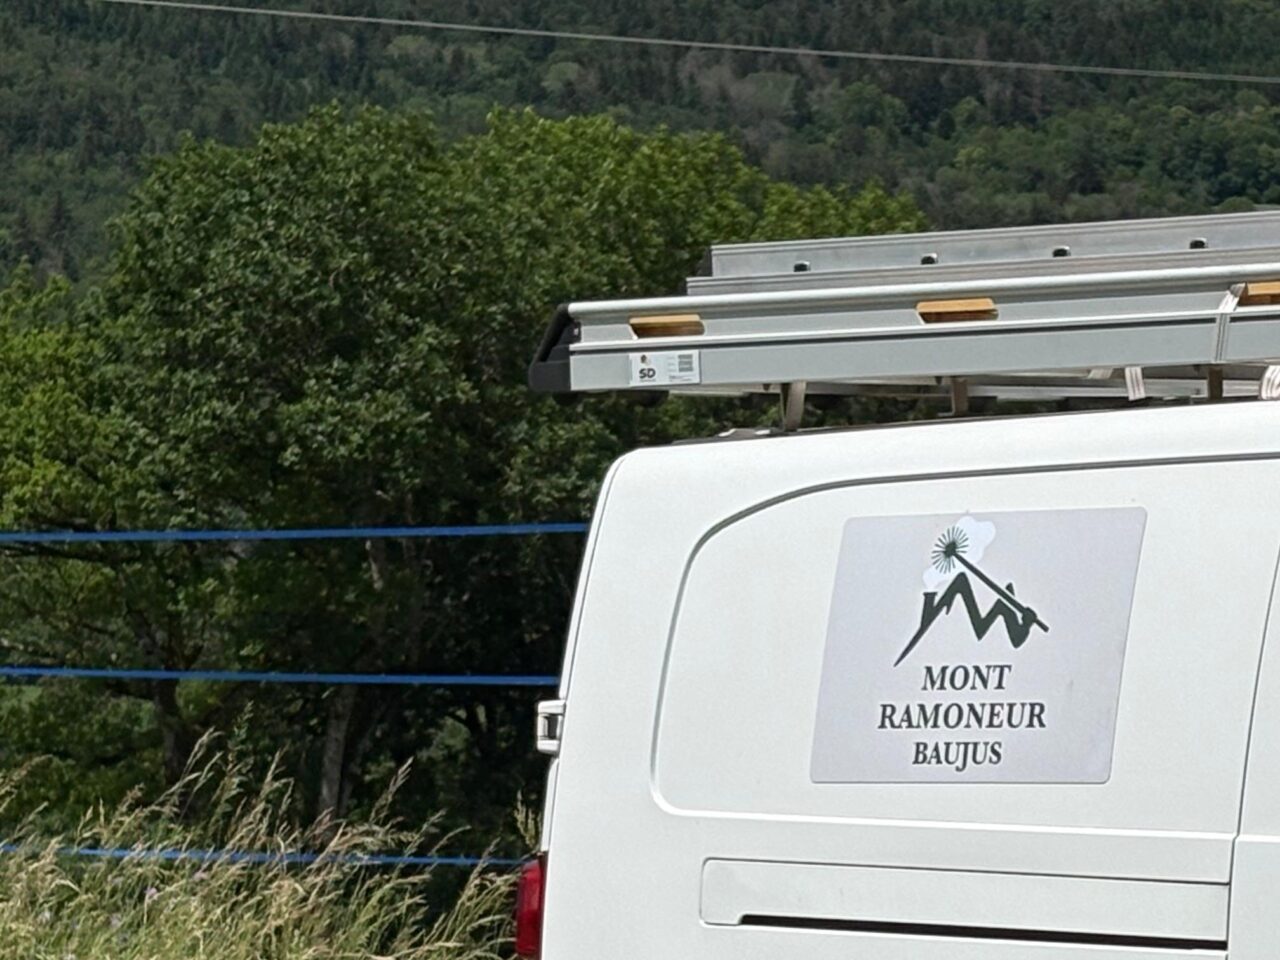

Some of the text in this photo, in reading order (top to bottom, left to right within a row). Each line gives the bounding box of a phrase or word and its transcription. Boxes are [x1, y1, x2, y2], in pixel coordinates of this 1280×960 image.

[638, 368, 656, 379] SD
[921, 665, 1012, 691] MONT
[877, 703, 1046, 729] RAMONEUR
[912, 741, 1002, 772] BAUJUS
